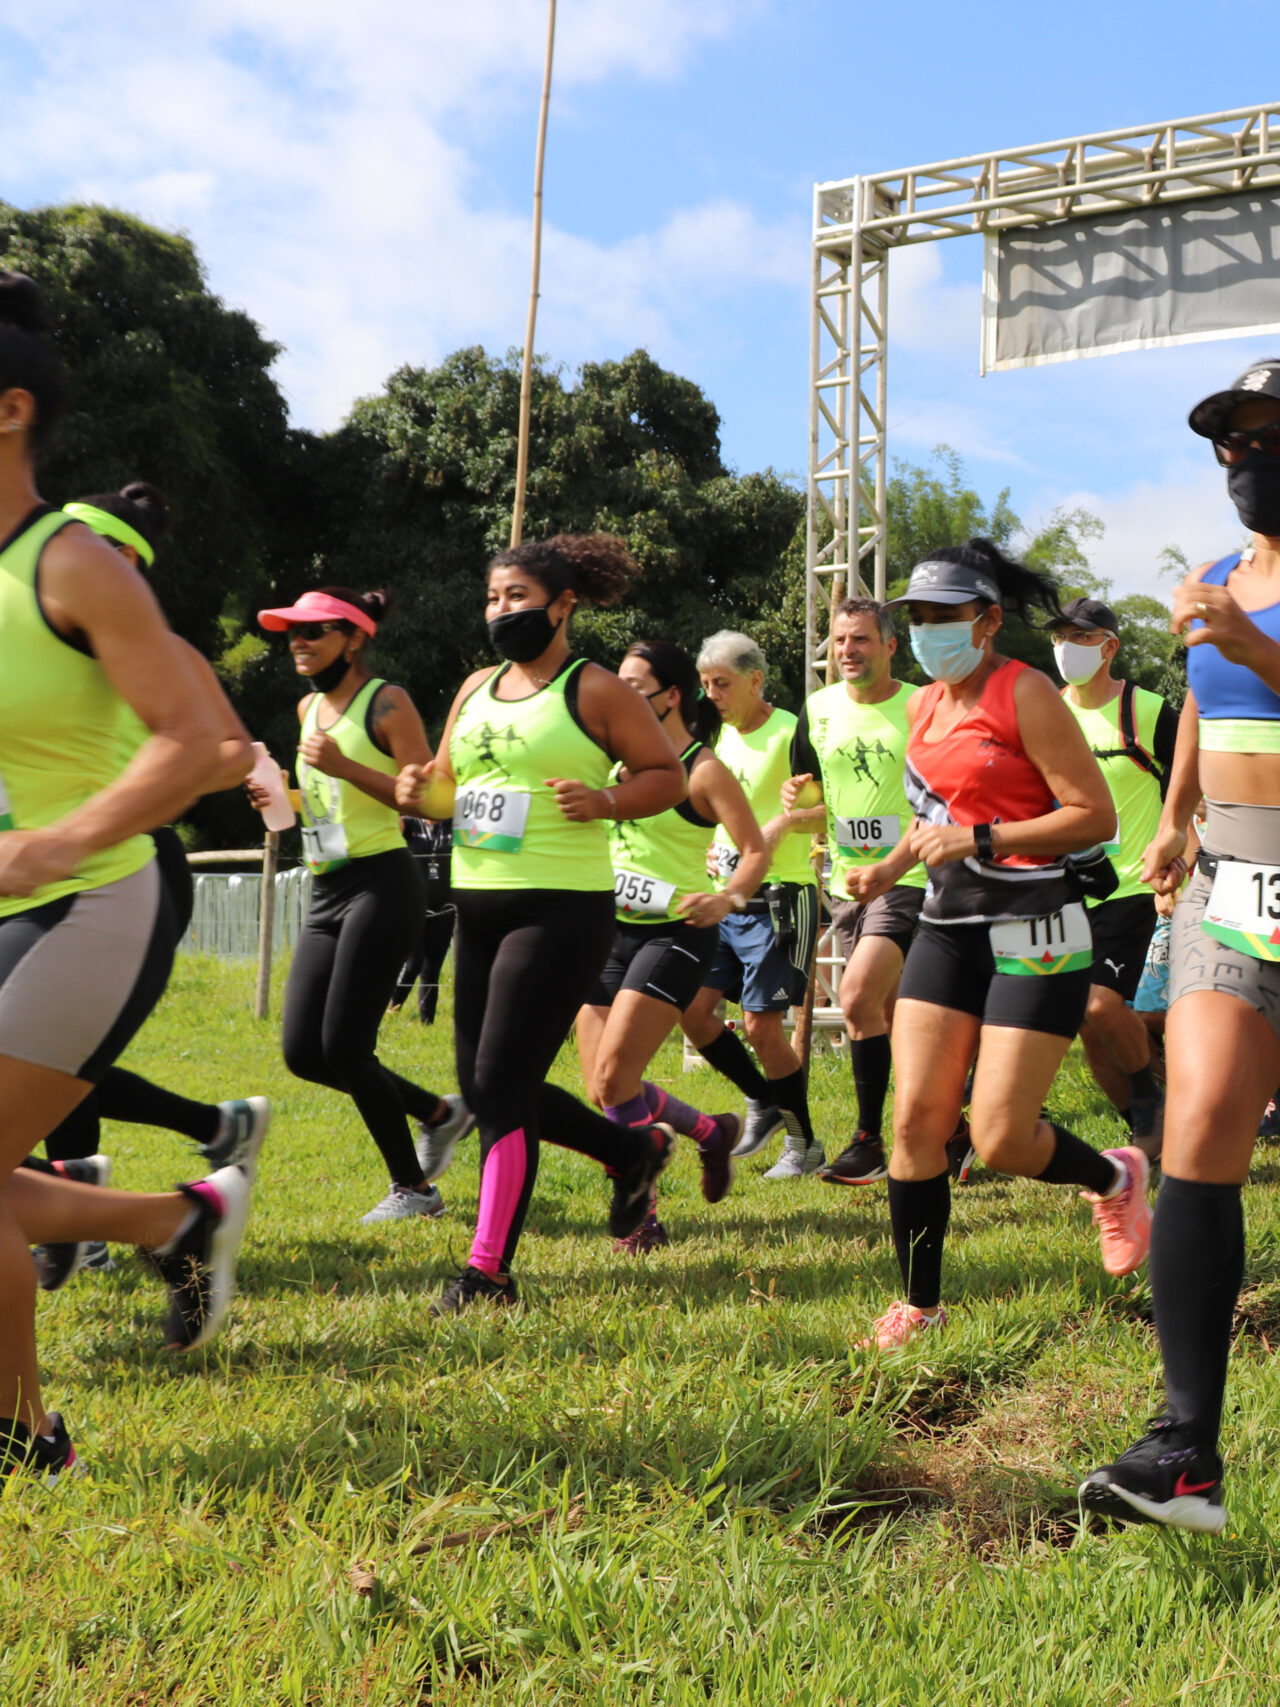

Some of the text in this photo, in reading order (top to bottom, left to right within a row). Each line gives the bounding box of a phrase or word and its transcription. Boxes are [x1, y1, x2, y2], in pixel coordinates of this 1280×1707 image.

[463, 791, 505, 822] 068
[848, 820, 882, 840] 106
[615, 873, 655, 904] 055
[1024, 911, 1065, 946] 111
